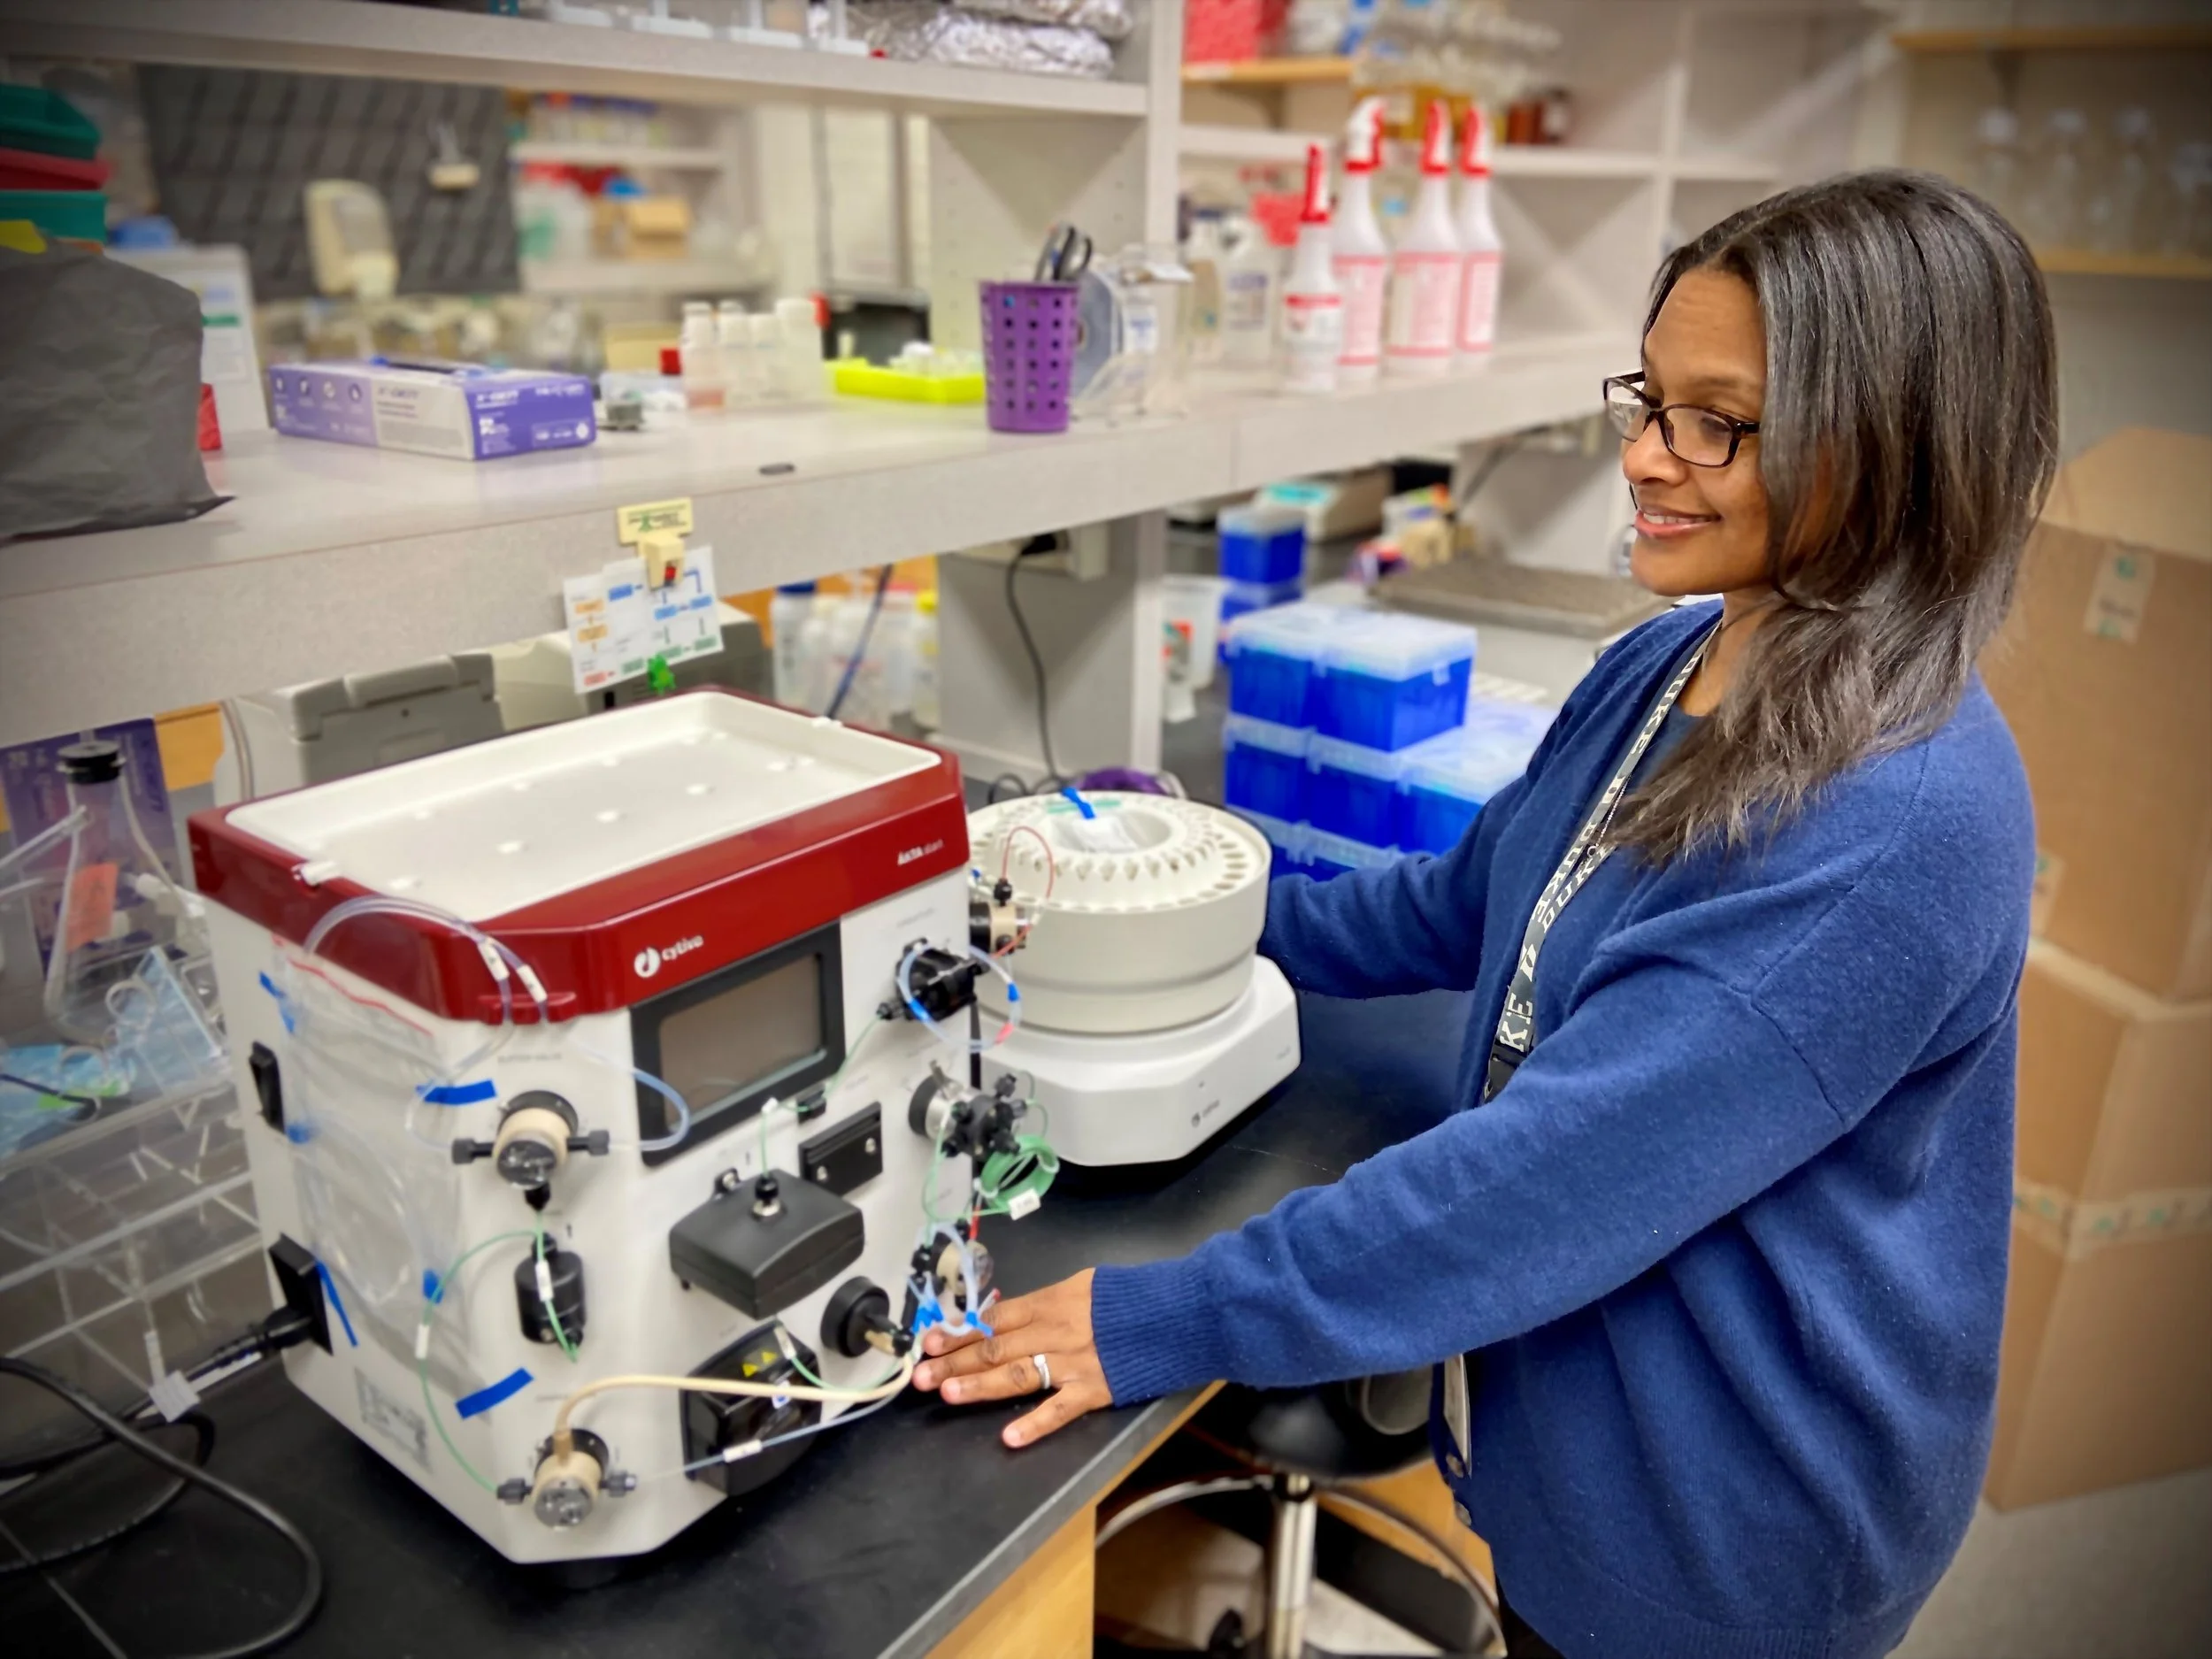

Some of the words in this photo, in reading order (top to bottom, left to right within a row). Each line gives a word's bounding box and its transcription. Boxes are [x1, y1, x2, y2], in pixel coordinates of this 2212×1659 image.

[1630, 653, 1703, 754] DUKE
[1532, 822, 1598, 923] DUKE
[1500, 993, 1533, 1053] KE
